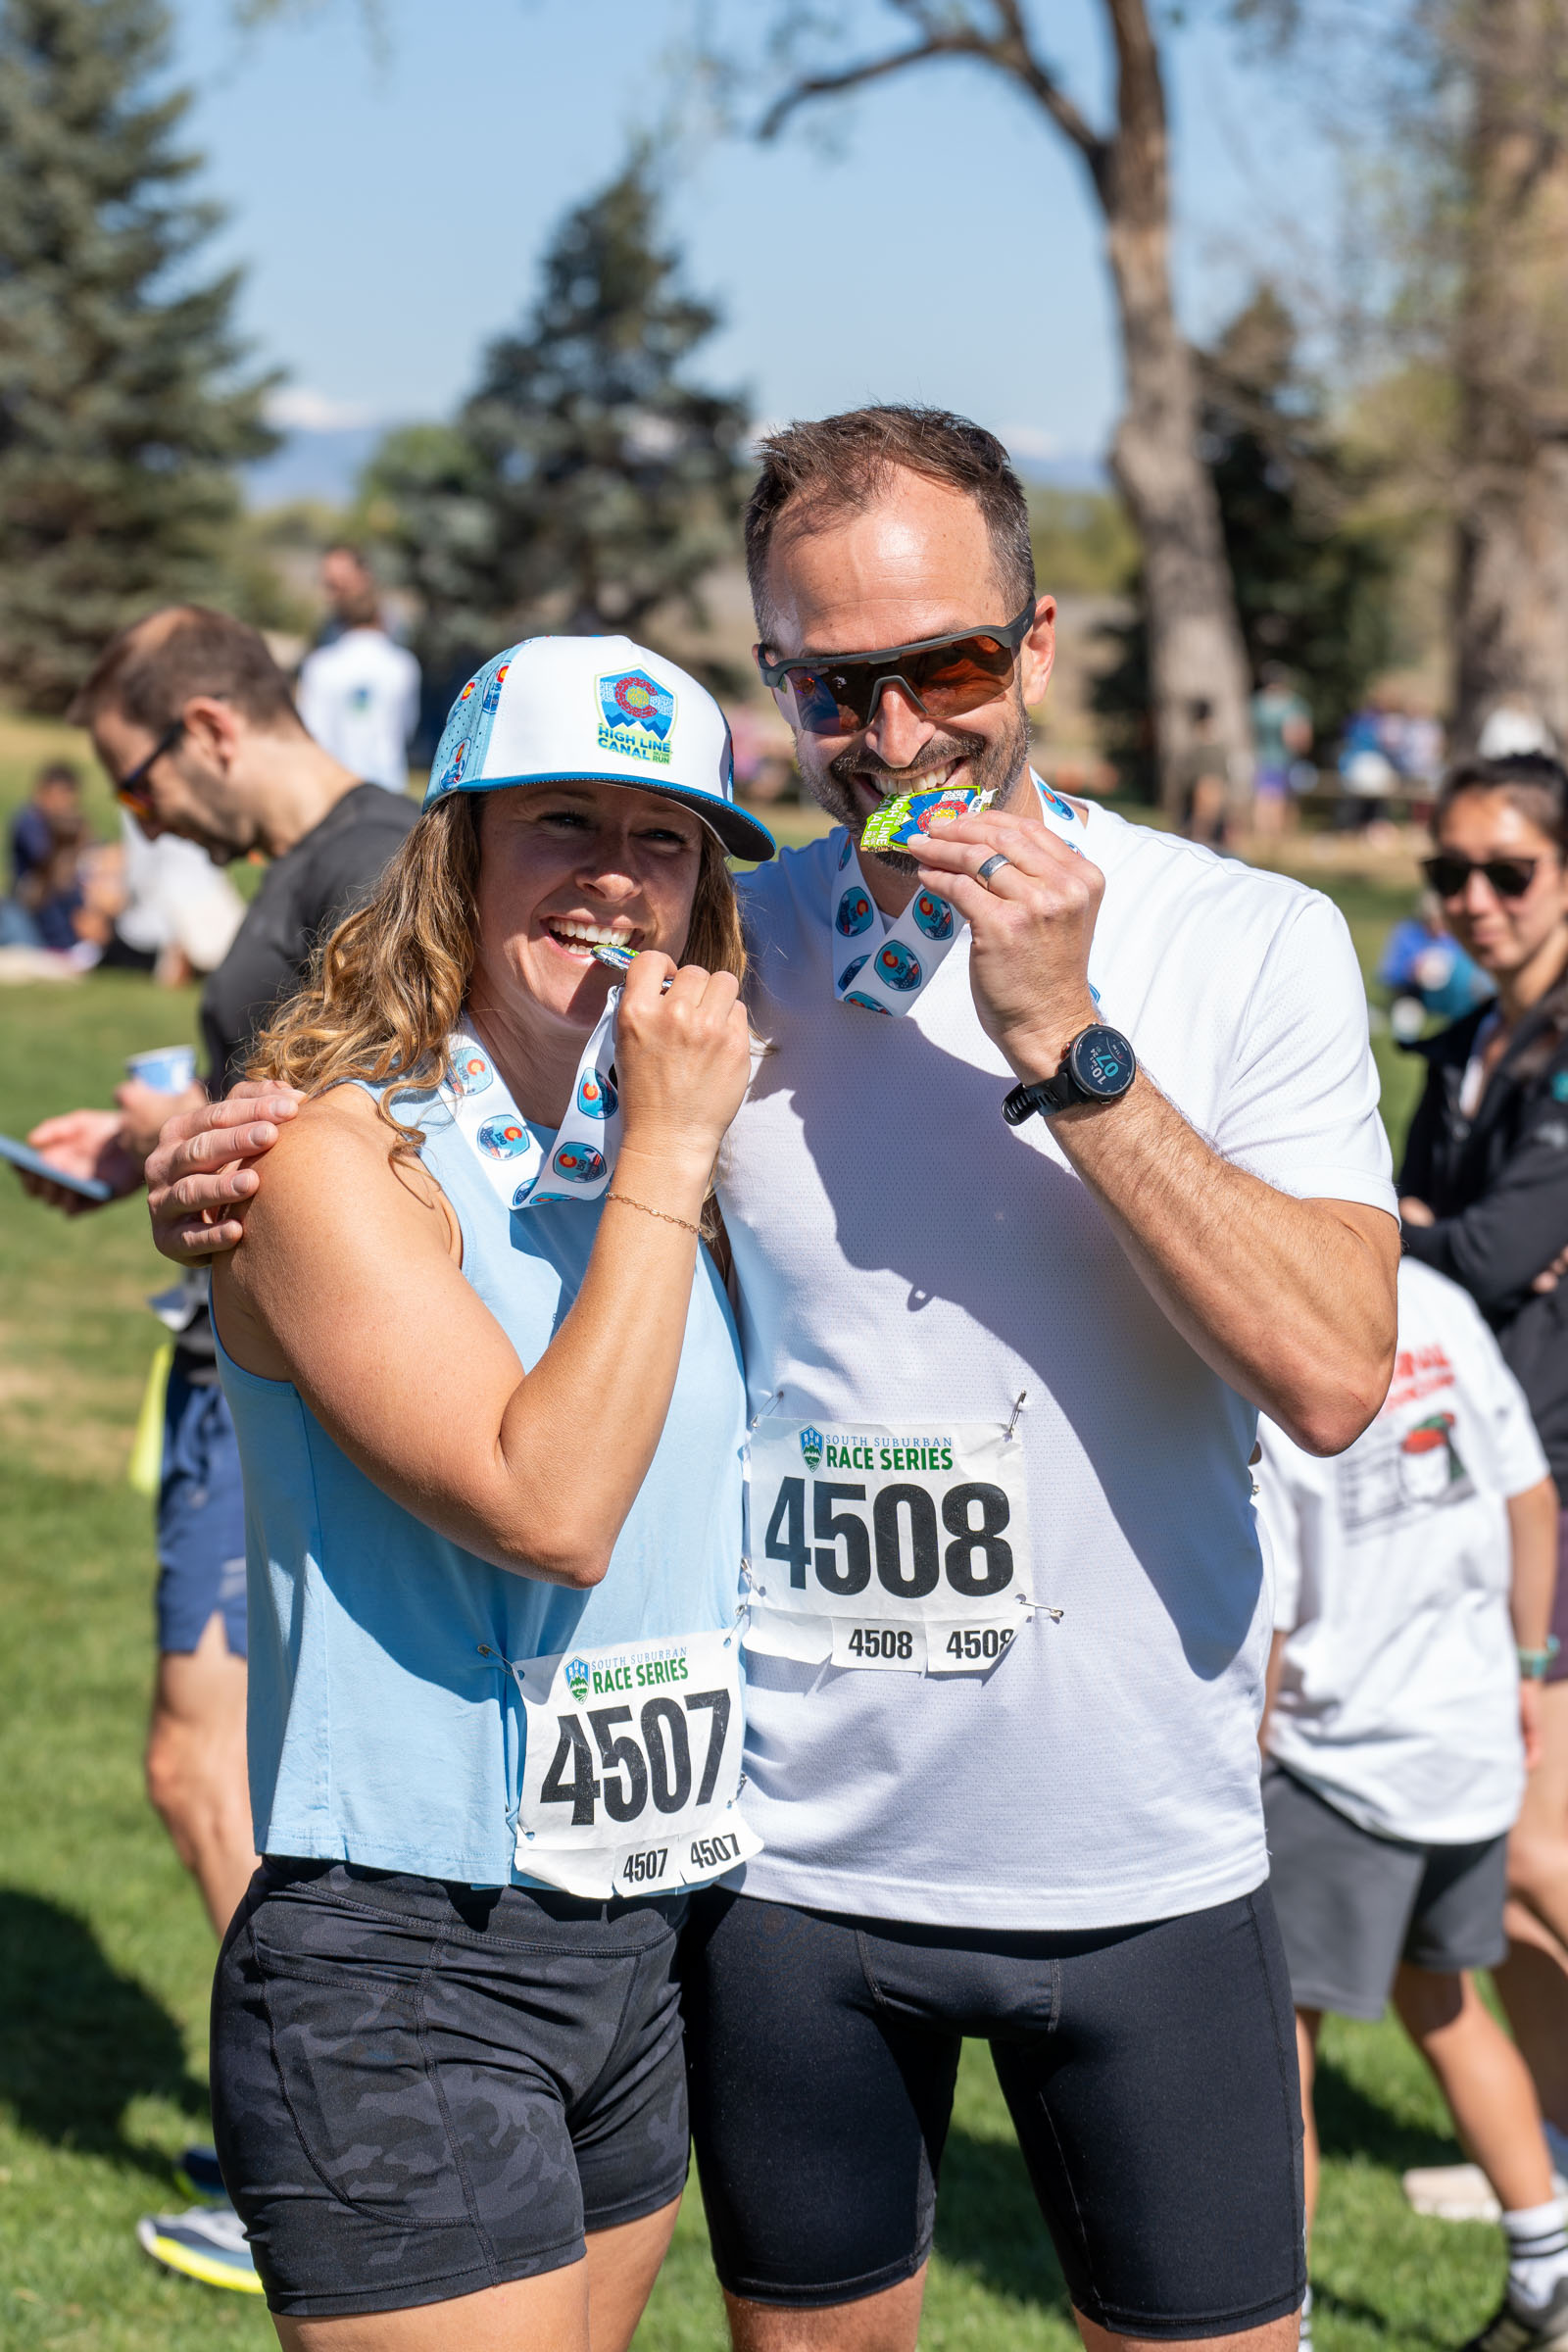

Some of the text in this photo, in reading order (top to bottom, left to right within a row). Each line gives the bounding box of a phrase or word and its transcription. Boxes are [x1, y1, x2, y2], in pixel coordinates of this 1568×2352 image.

[598, 726, 671, 753] HIGH LINE
[598, 737, 651, 760] CANAL
[653, 755, 670, 764] RUN
[876, 820, 894, 846] LINE
[895, 962, 906, 975] 150
[1092, 1067, 1106, 1085] 10
[1095, 1054, 1119, 1077] 07
[495, 1132, 508, 1145] 150
[576, 1159, 587, 1171] 150
[825, 1434, 953, 1447] SOUTH SUBURBAN
[826, 1446, 954, 1471] RACE SERIES
[764, 1476, 1014, 1598] 4508
[848, 1629, 913, 1659] 4508
[591, 1647, 688, 1671] SOUTH SUBURBAN
[592, 1657, 689, 1694] RACE SERIES
[540, 1688, 731, 1826] 4507
[690, 1833, 742, 1869] 4507
[623, 1847, 668, 1884] 4507
